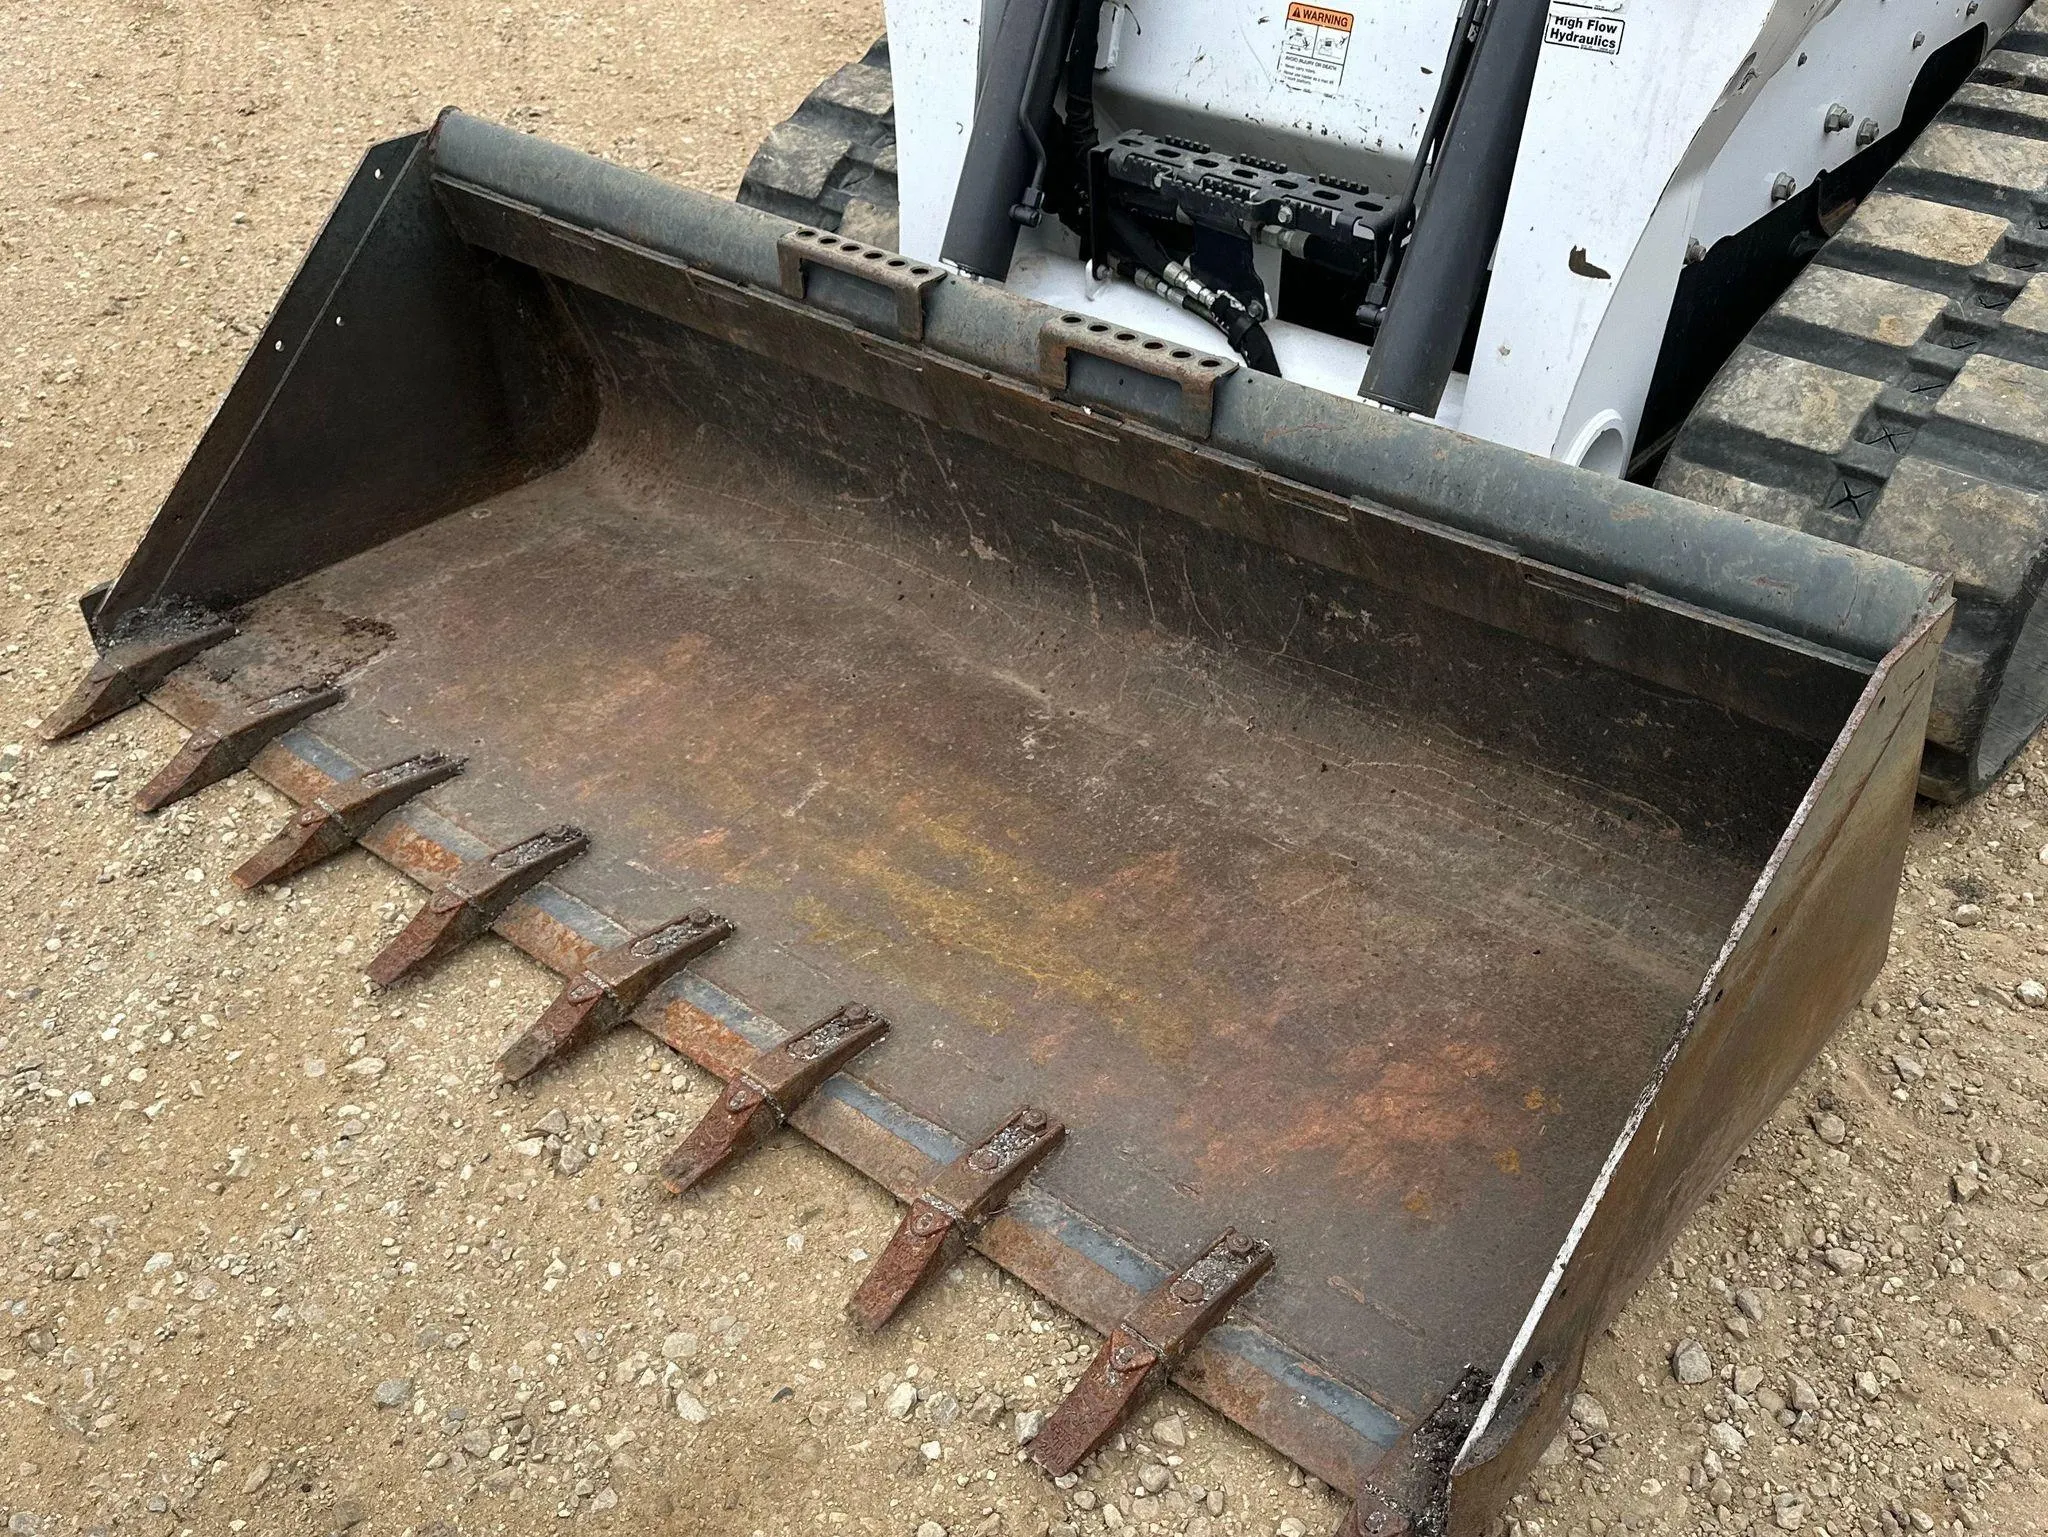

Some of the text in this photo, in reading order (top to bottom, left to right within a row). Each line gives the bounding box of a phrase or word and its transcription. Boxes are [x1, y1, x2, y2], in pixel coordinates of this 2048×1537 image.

[1303, 9, 1348, 27] WARNING
[1555, 16, 1618, 34] High Flow
[1550, 28, 1616, 49] Hydraulics
